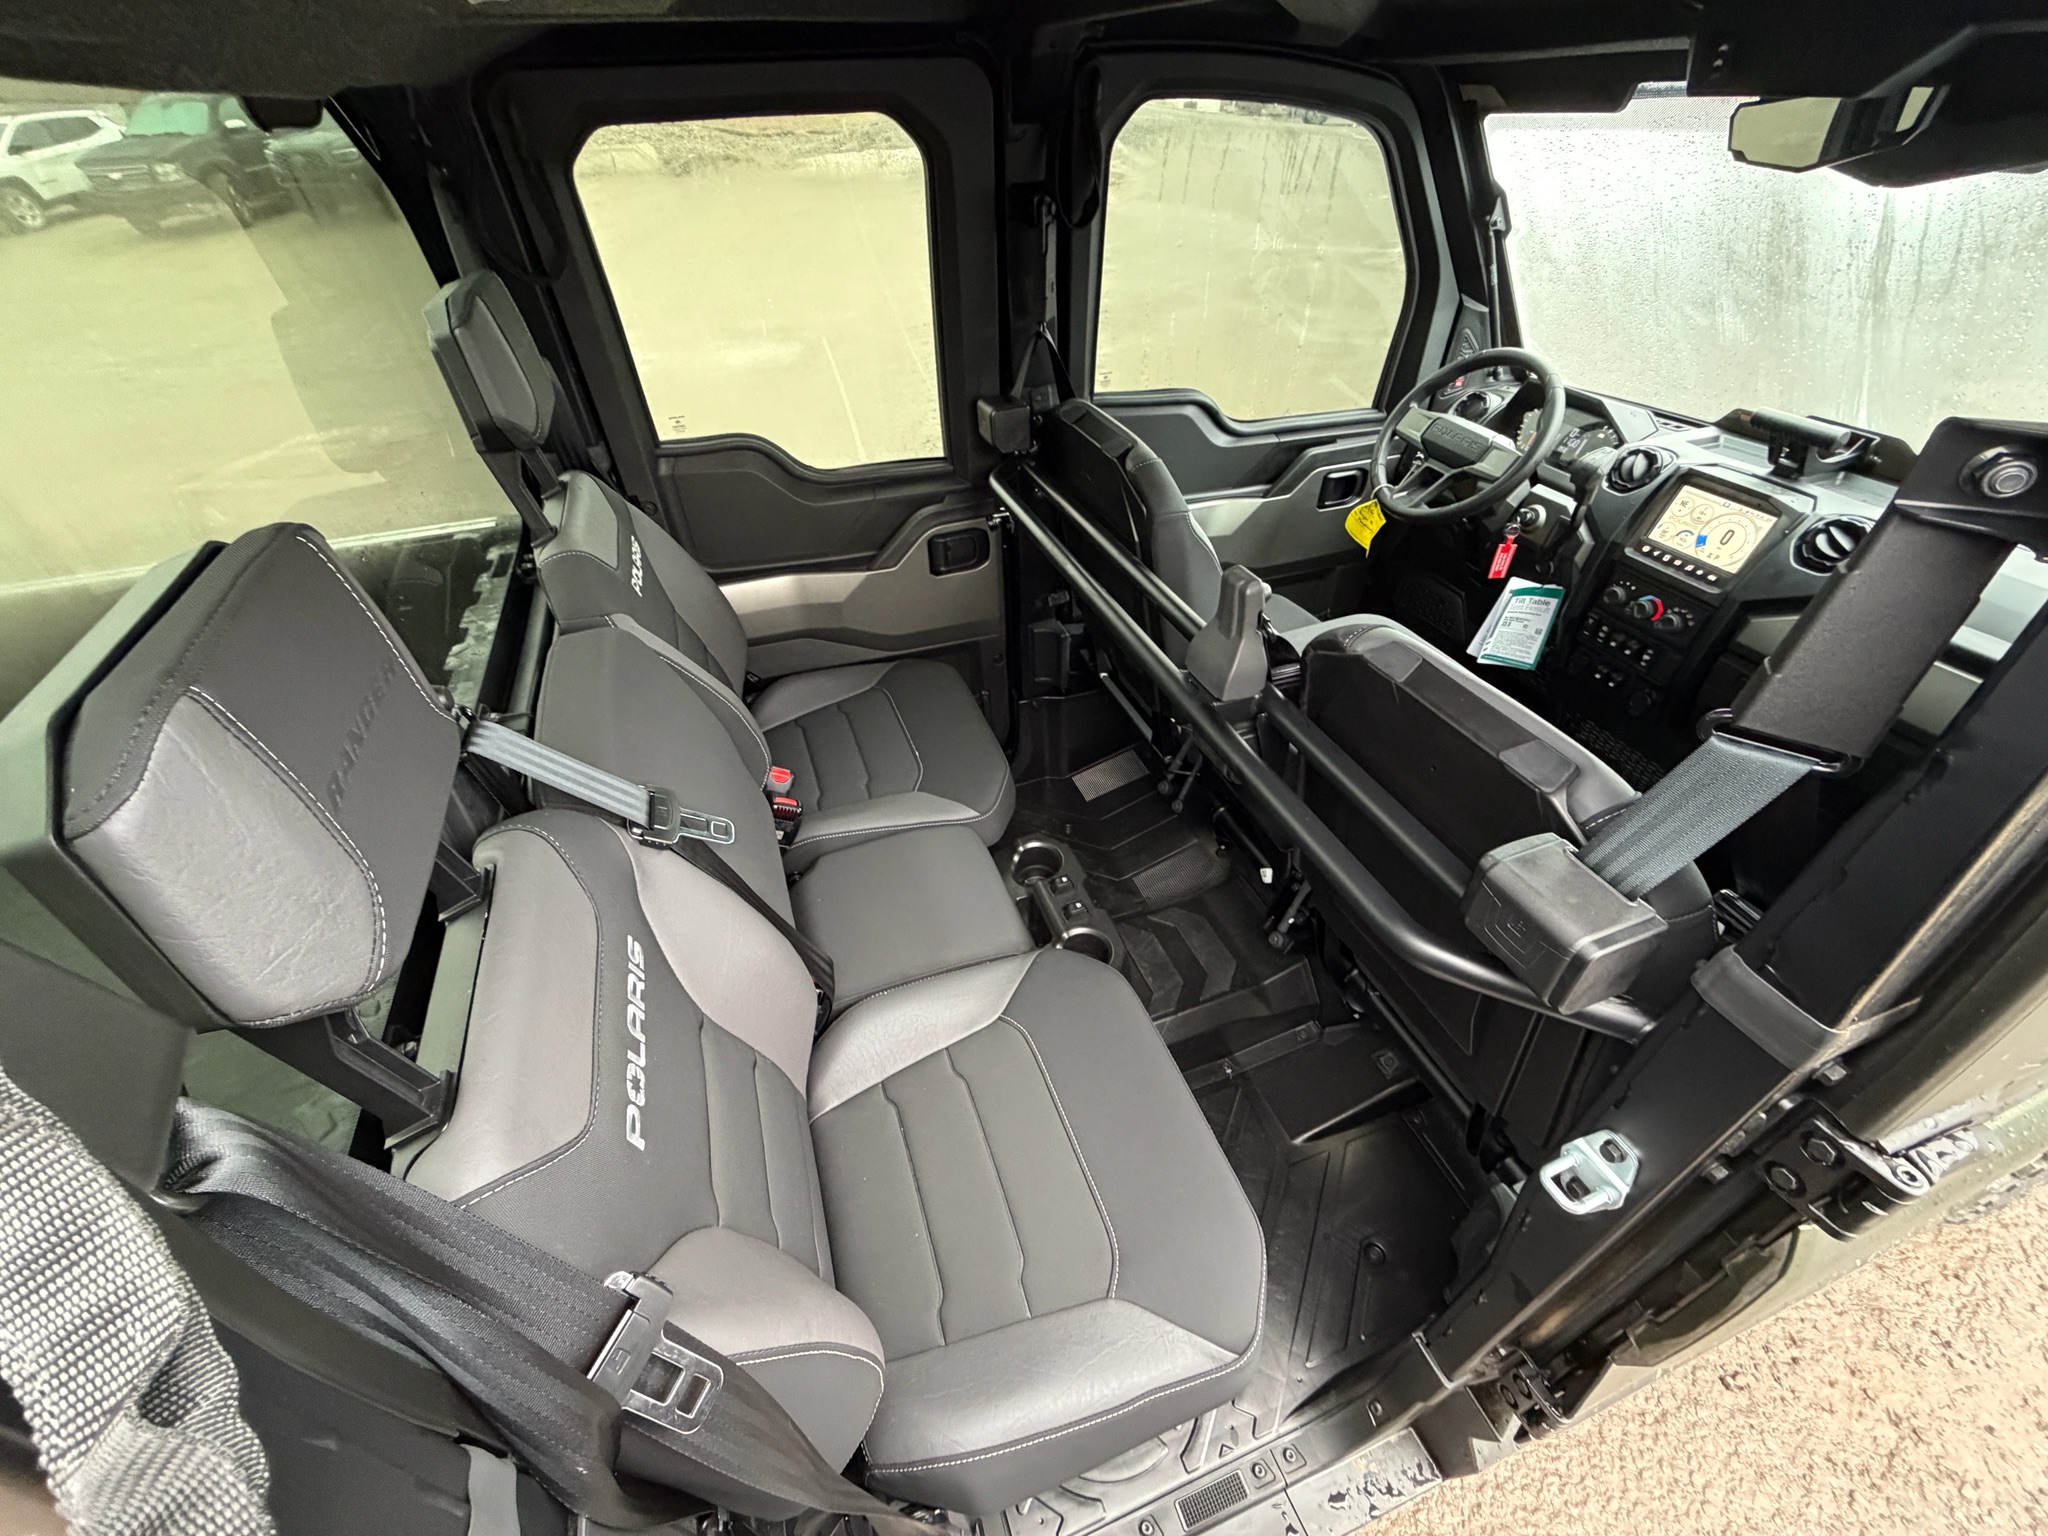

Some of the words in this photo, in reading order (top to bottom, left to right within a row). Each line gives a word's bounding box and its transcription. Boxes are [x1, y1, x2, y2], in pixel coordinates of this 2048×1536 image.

[1430, 422, 1485, 453] POLARIS
[1719, 529, 1735, 546] 0
[630, 534, 643, 598] POLARIS
[1528, 597, 1551, 607] Table
[327, 657, 397, 814] RANGER
[625, 935, 647, 1151] POLARIS
